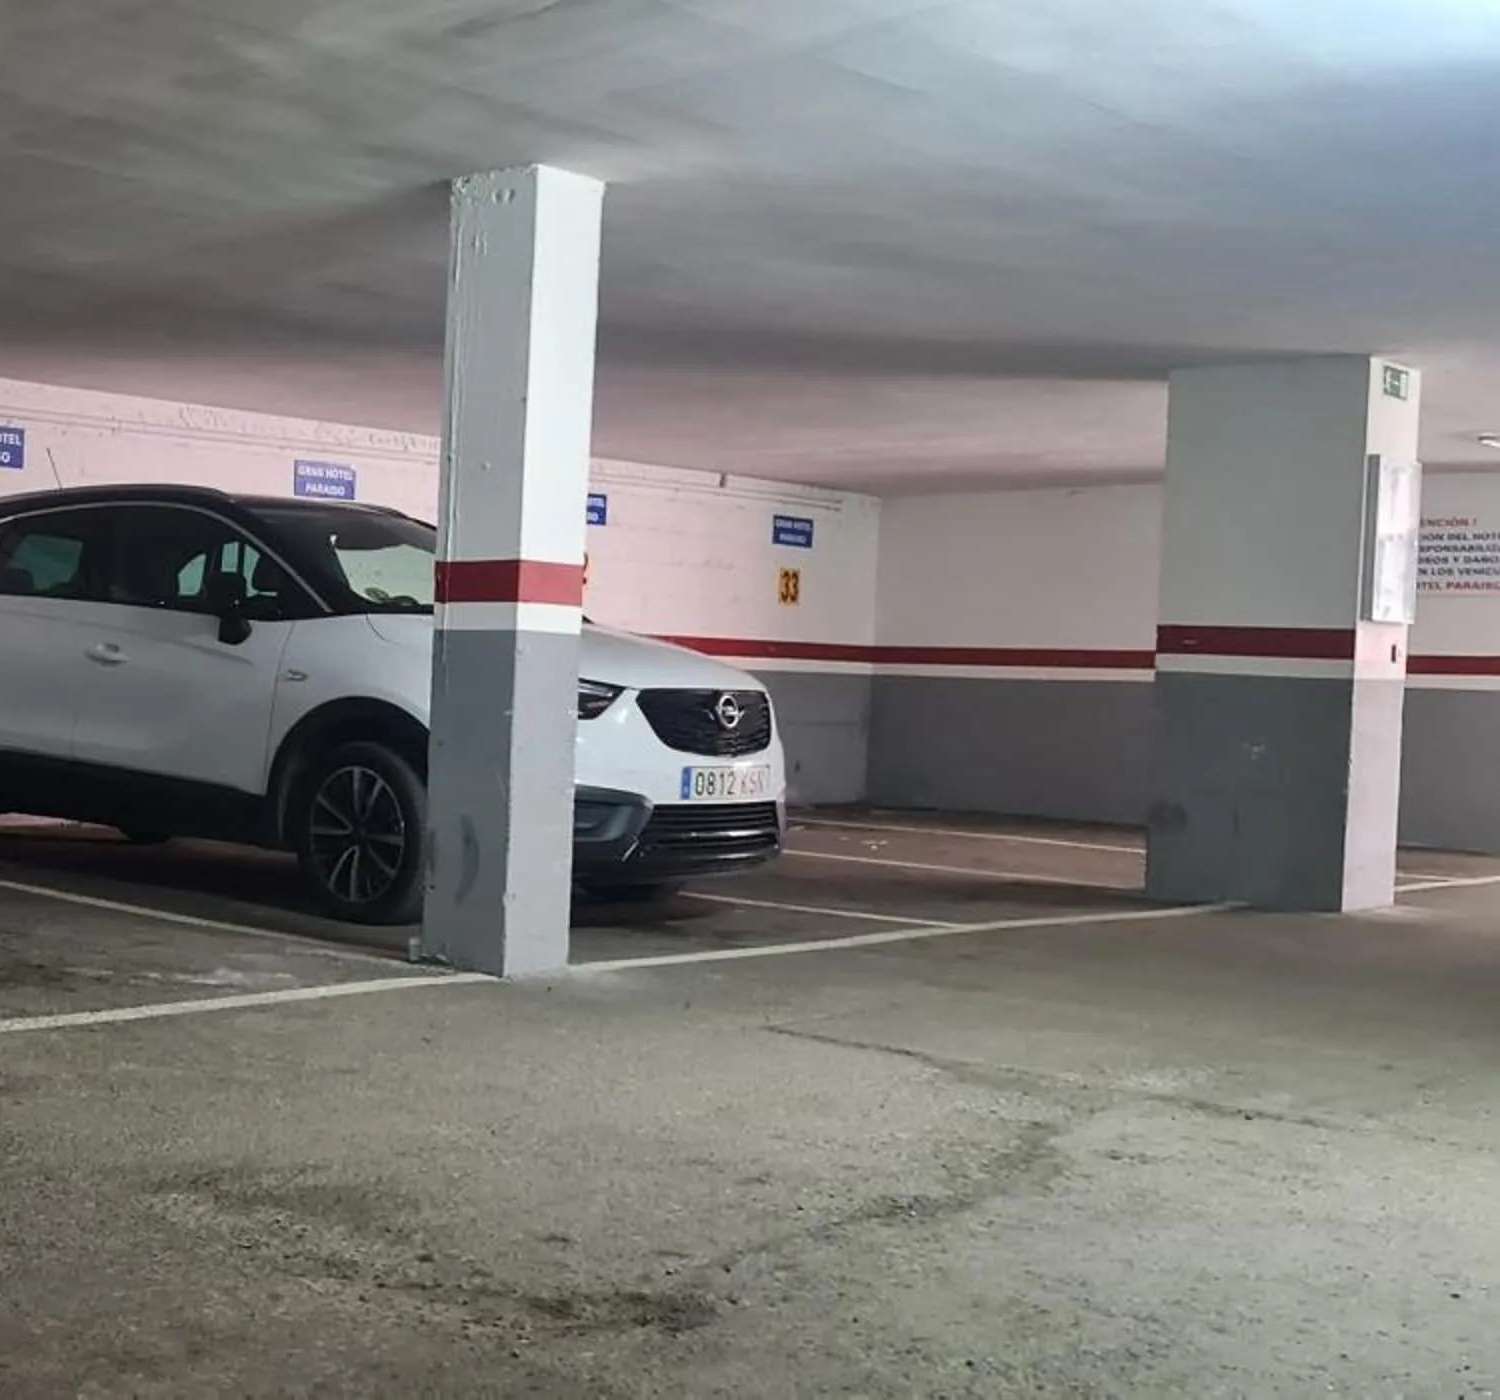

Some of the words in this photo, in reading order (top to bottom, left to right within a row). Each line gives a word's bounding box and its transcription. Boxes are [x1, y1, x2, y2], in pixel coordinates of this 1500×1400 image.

[1420, 516, 1468, 527] ENCIÓN
[780, 570, 800, 603] 33
[695, 771, 737, 796] 0812
